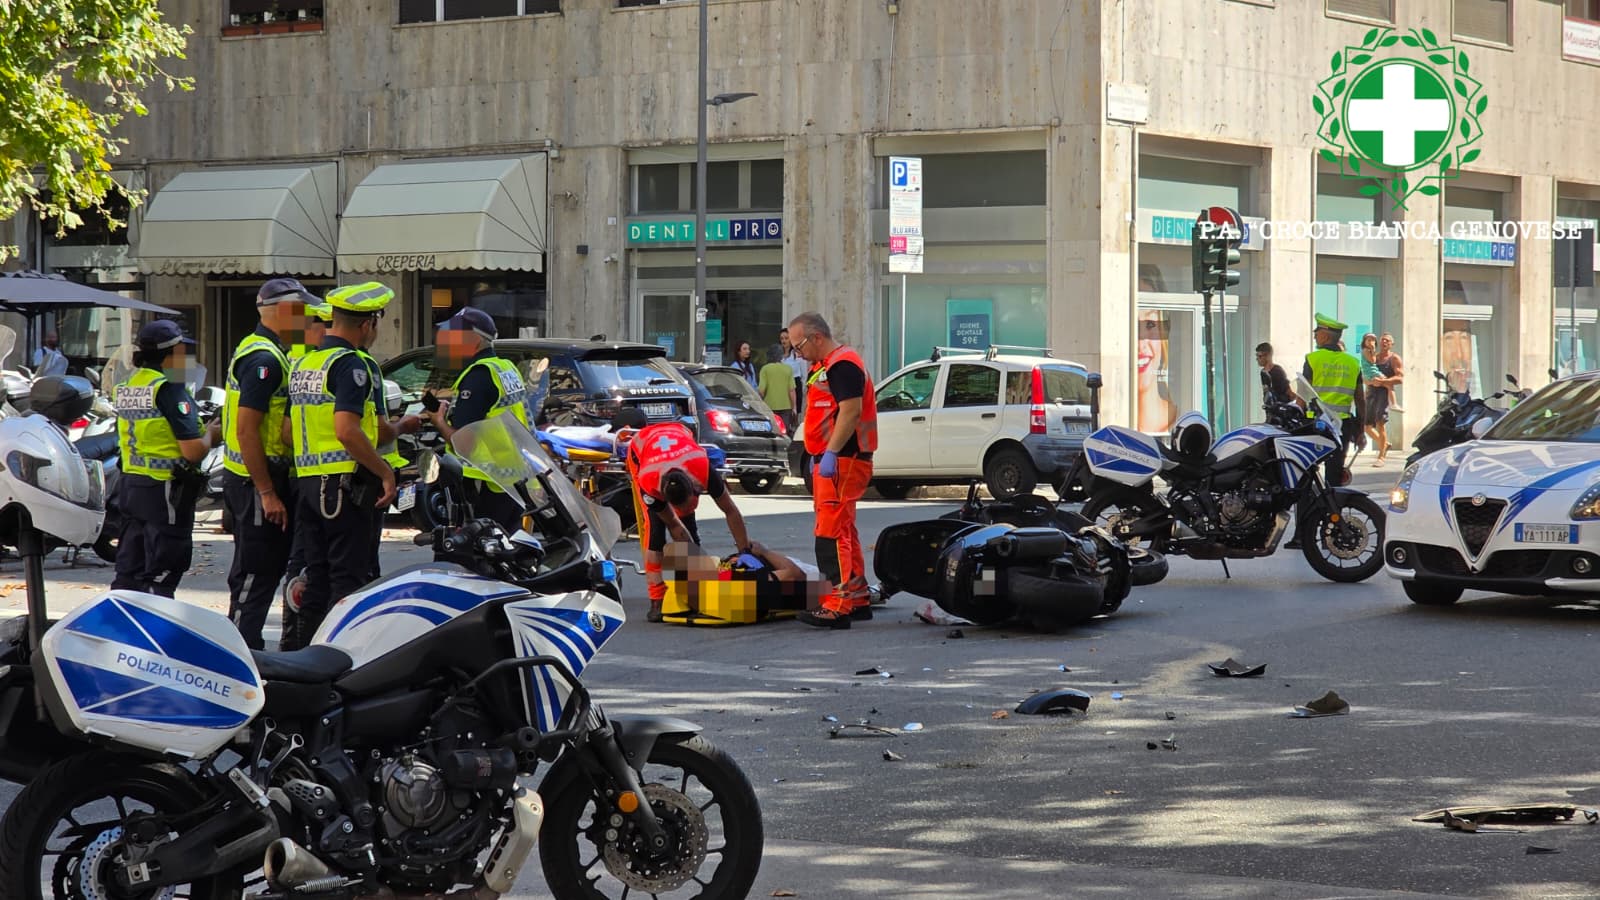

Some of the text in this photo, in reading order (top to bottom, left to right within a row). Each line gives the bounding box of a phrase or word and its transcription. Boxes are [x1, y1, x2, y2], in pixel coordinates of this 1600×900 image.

[376, 254, 436, 269] CREPERIA
[116, 387, 151, 397] POLIZIA
[116, 398, 152, 408] LOCALE
[116, 652, 232, 698] POLIZIA LOCALE
